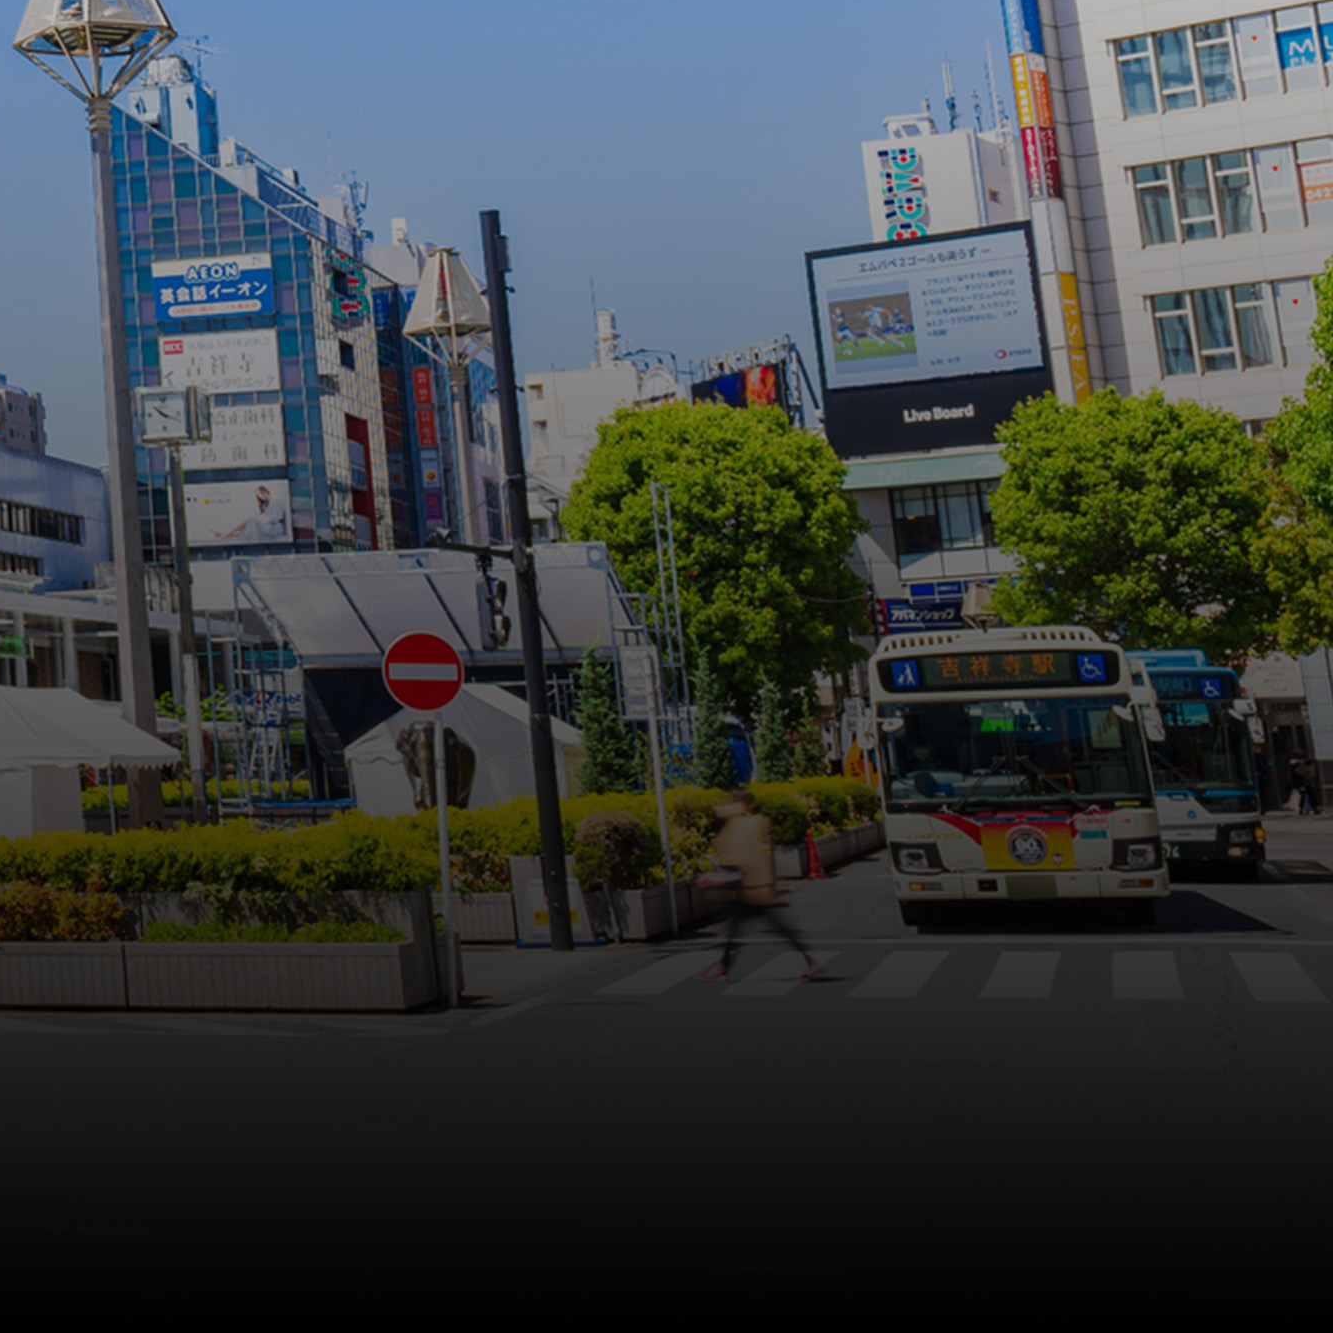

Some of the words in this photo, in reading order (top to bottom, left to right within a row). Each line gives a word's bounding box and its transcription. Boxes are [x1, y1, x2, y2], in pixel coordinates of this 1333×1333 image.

[877, 147, 928, 241] PARC
[185, 263, 239, 282] AEON
[160, 280, 268, 305] 英会話イーオン
[933, 404, 975, 421] Board
[937, 653, 1057, 678] 吉祥寺駅
